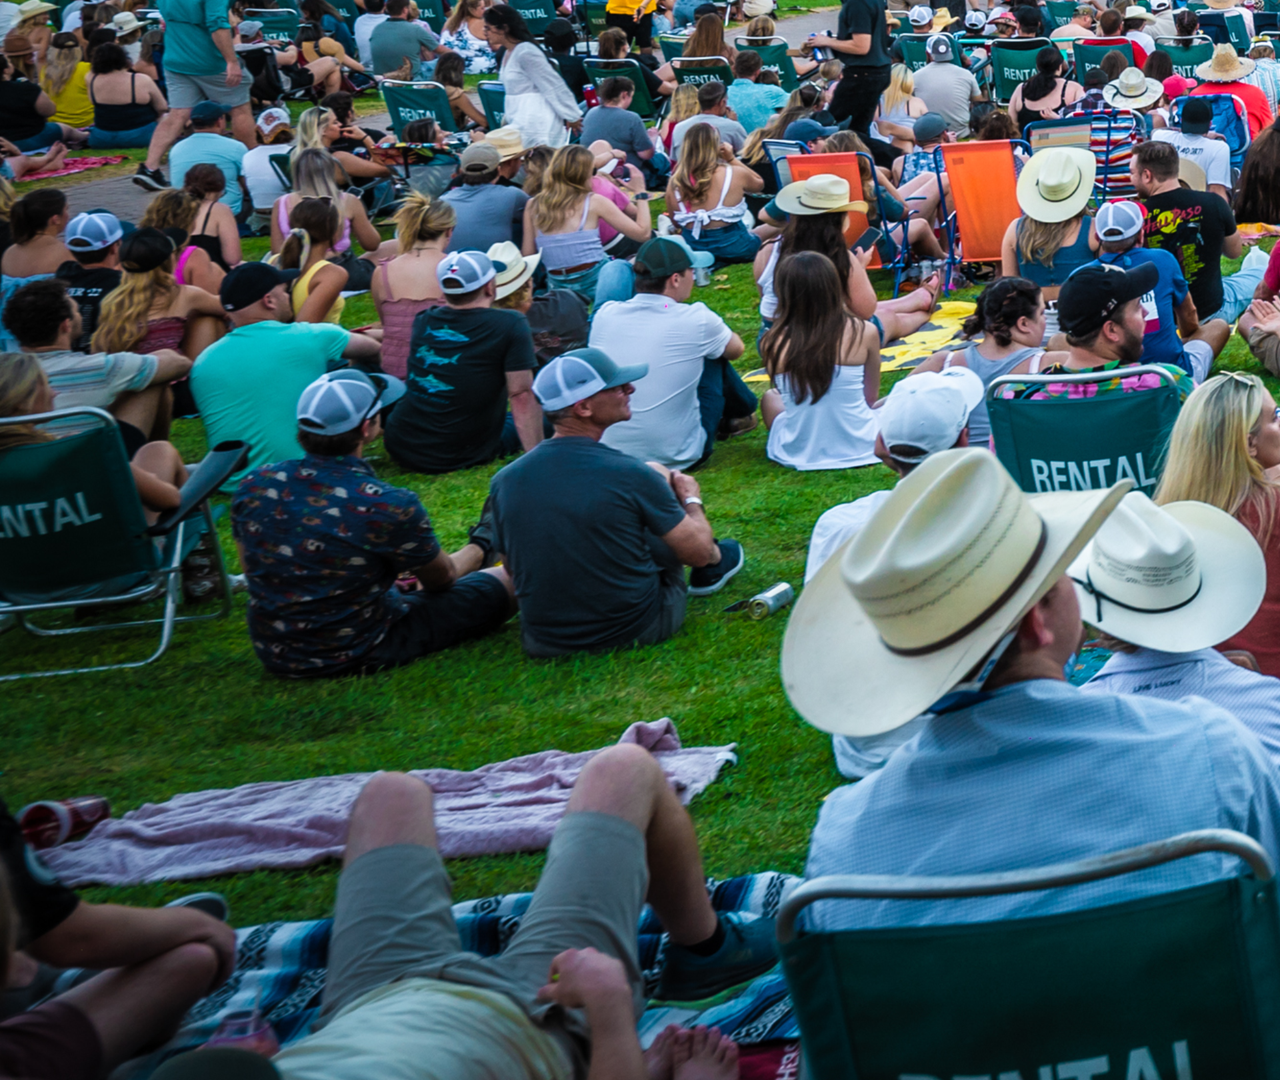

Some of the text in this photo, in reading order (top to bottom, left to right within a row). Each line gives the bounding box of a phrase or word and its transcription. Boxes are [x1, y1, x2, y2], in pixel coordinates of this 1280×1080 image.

[418, 8, 437, 19] TAL
[517, 7, 549, 20] ENTAL
[683, 74, 725, 87] RENTAL
[1003, 67, 1039, 81] RENTA
[399, 108, 438, 123] RENTAL
[1030, 452, 1156, 493] RENTAL
[0, 491, 103, 538] NTAL
